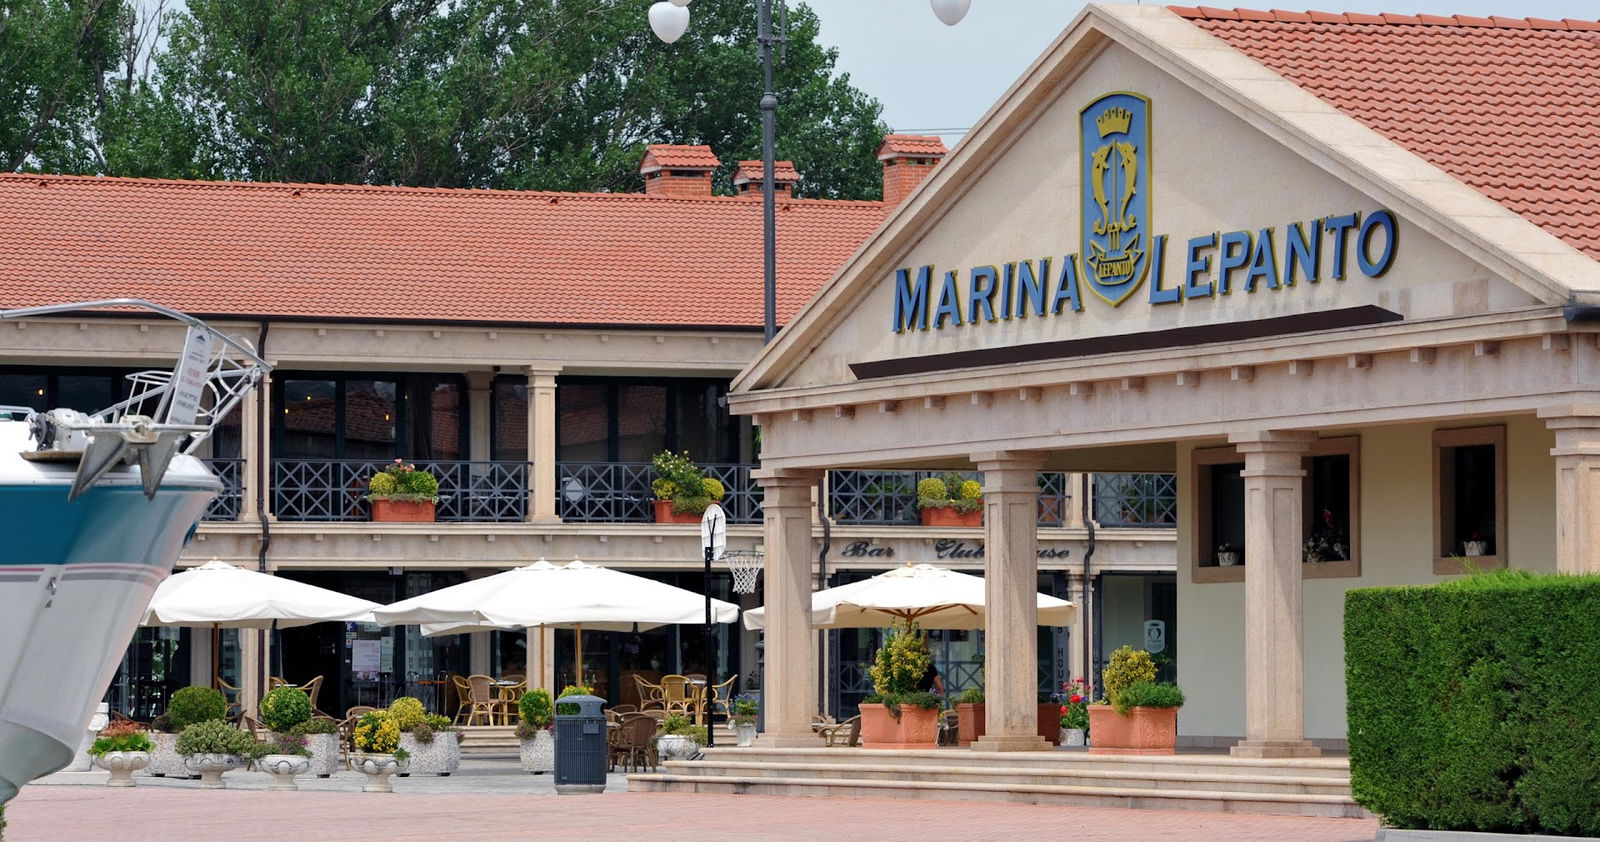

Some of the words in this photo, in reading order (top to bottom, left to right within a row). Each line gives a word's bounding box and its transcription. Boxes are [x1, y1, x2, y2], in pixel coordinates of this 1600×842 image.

[893, 253, 1085, 334] MARINA
[1148, 209, 1399, 305] LEPANTO
[841, 541, 896, 558] Bar
